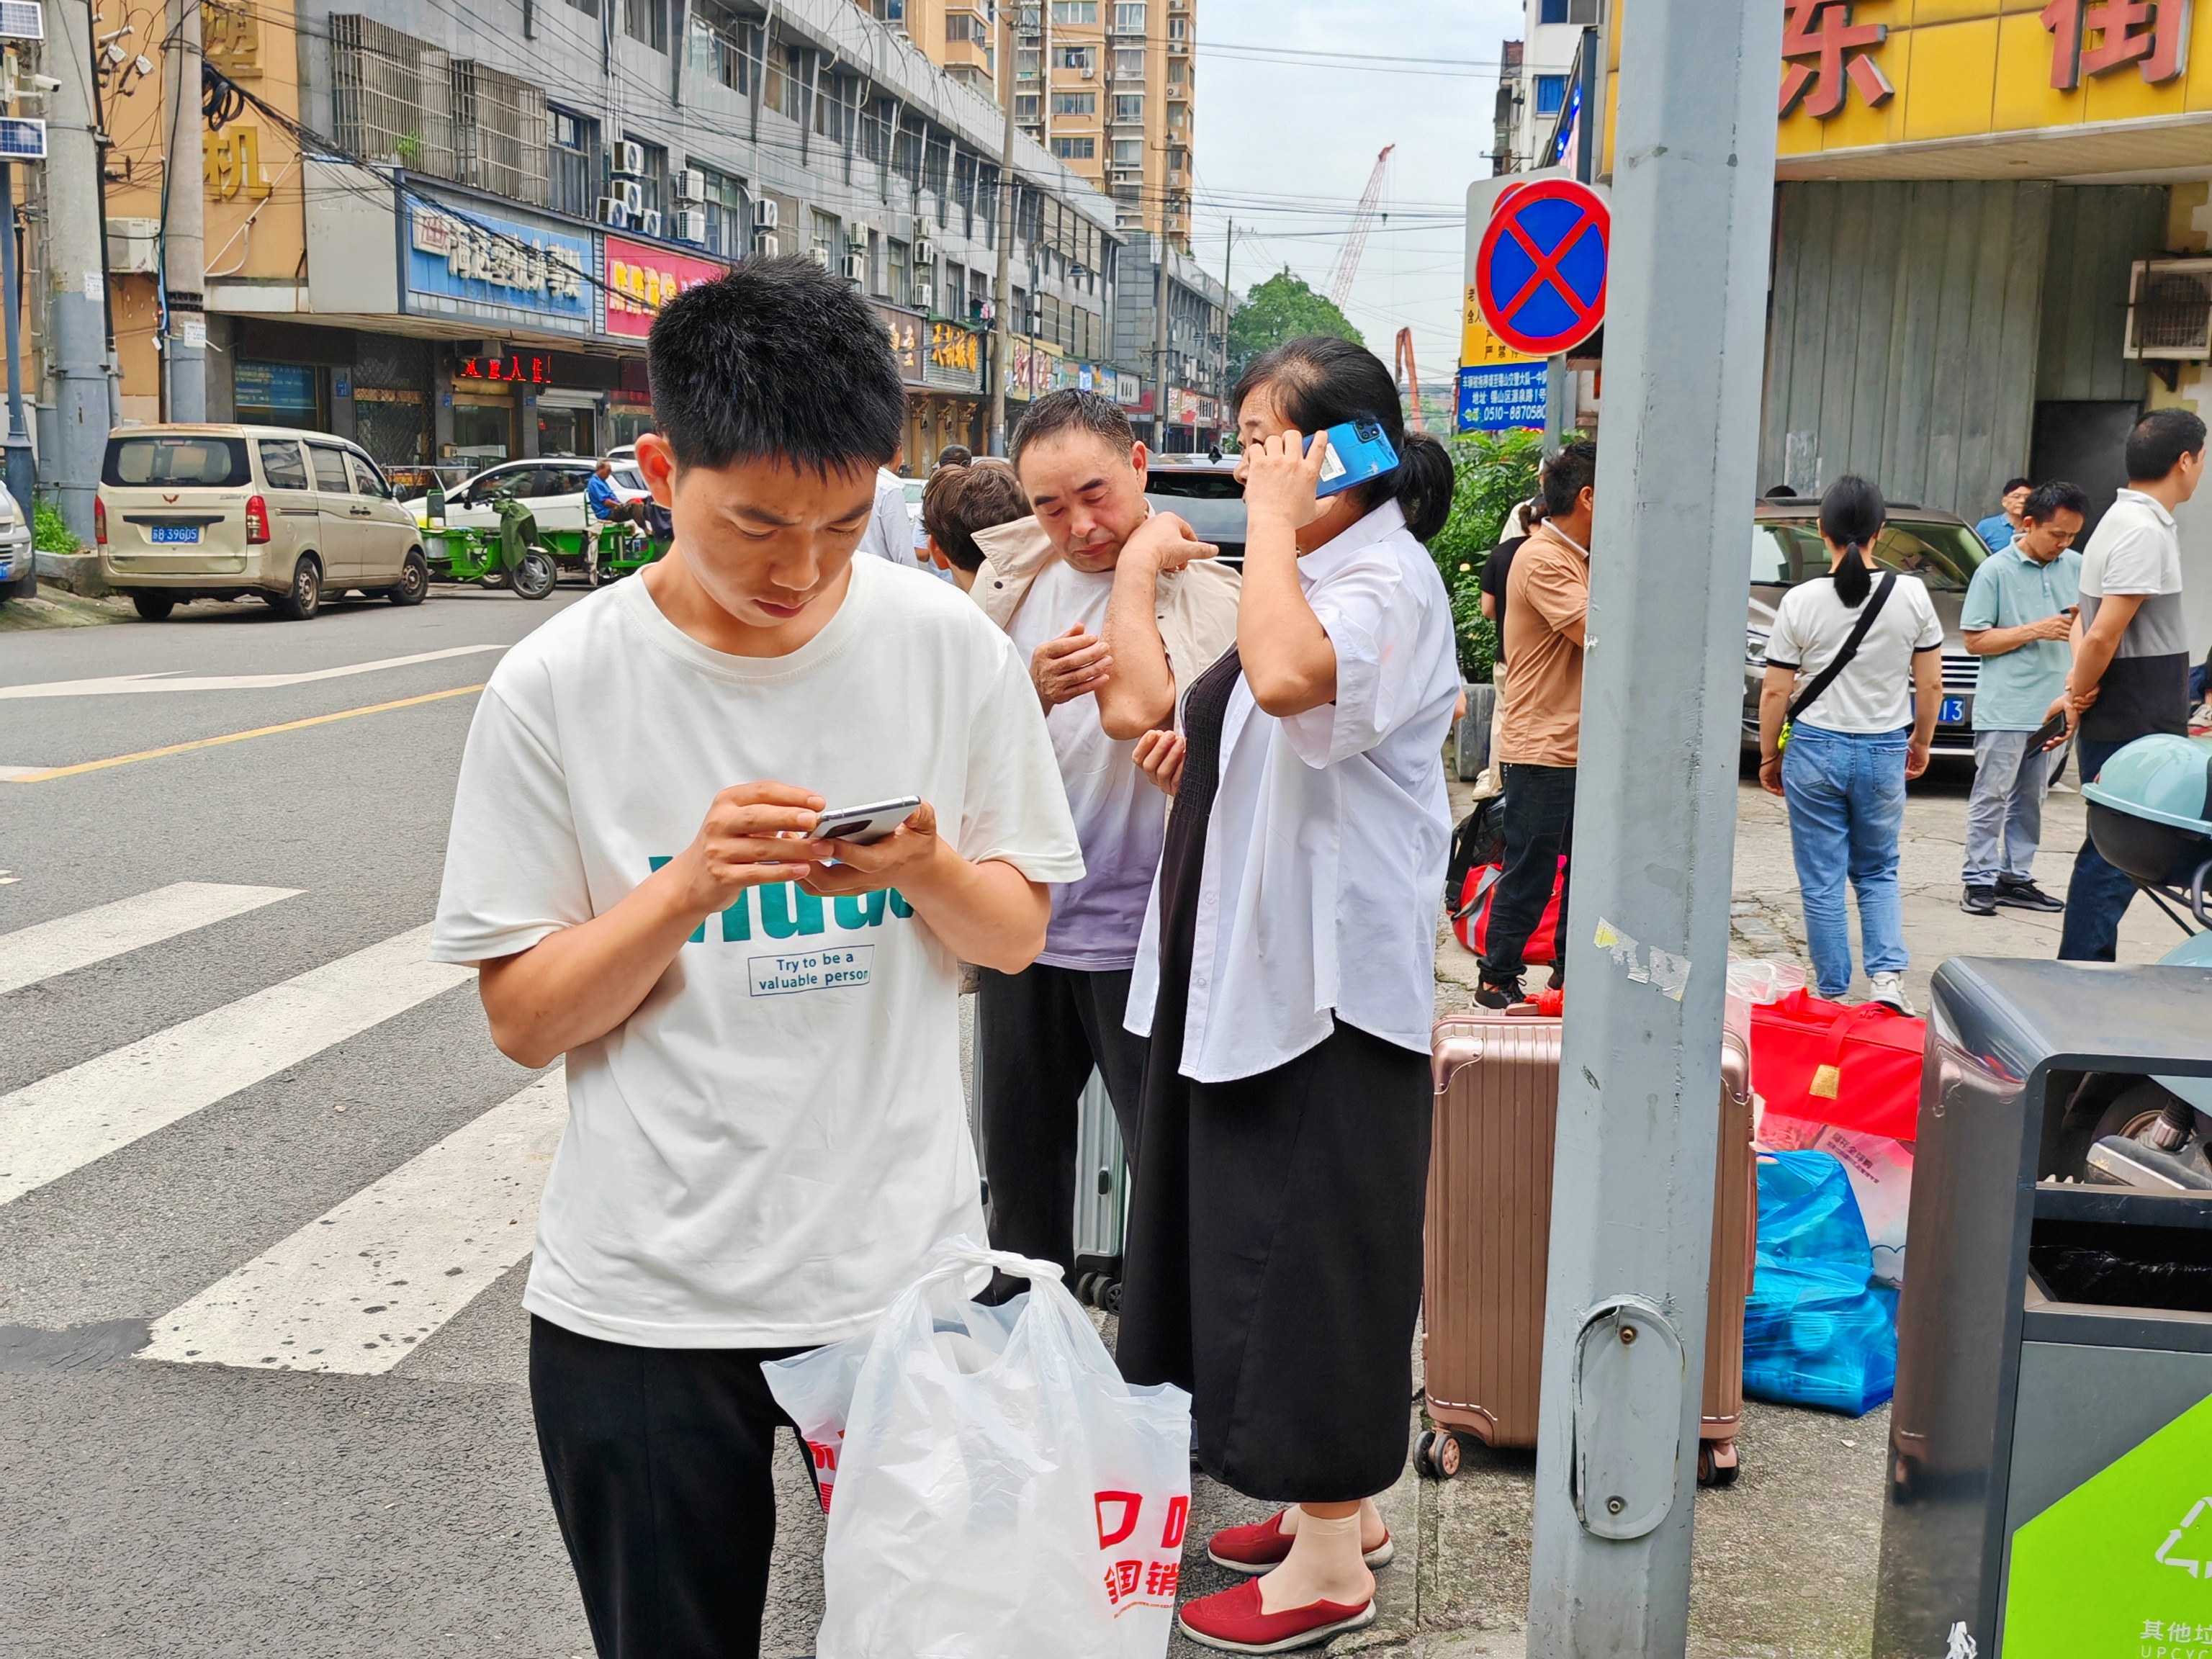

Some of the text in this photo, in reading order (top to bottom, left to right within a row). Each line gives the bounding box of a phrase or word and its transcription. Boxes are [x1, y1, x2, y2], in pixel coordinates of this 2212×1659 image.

[776, 953, 854, 973] Try to be a
[759, 972, 818, 990] valuable
